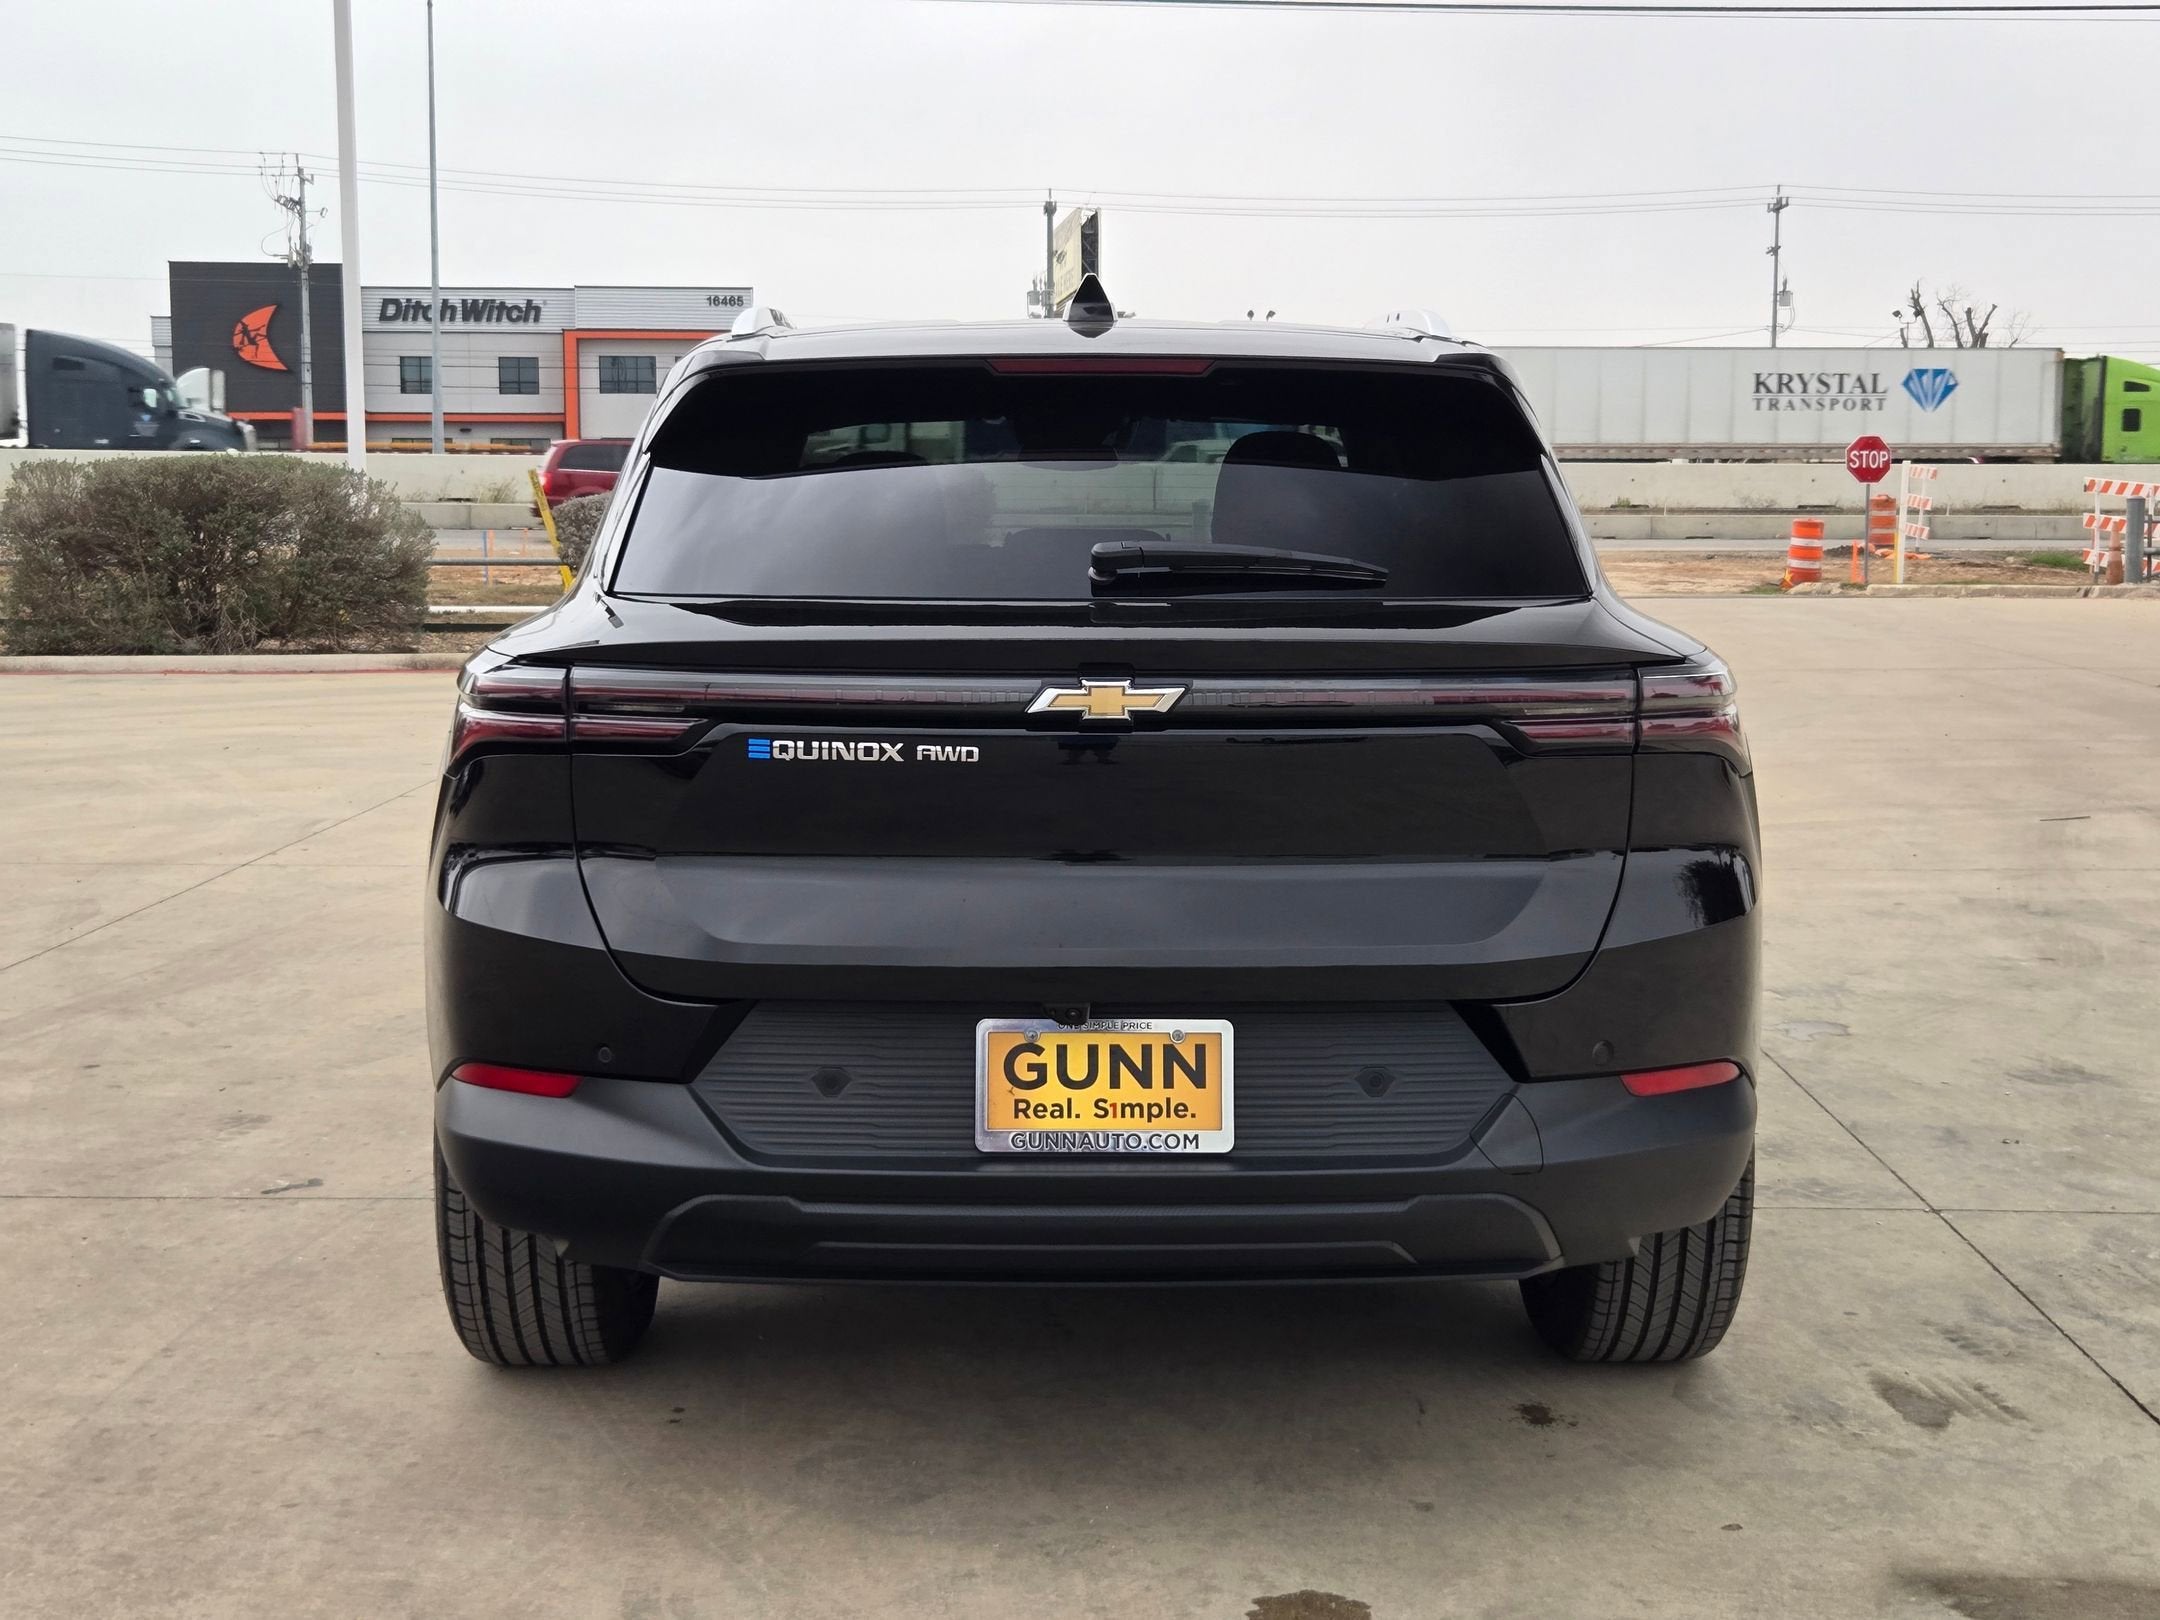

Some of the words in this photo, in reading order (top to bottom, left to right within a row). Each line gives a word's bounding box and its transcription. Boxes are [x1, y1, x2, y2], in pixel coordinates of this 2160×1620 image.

[706, 295, 744, 307] 16465
[1752, 372, 1889, 395] KRYSTAL
[1753, 398, 1888, 411] TRANSPORT
[1849, 450, 1890, 470] STOP
[916, 744, 980, 763] AWD
[1083, 1021, 1120, 1030] SIMPLE
[1122, 1021, 1153, 1030] PRICE
[1003, 1042, 1207, 1090] GUNN
[1013, 1097, 1081, 1119] Real.
[1011, 1132, 1200, 1150] GUNNAUTO.COM
